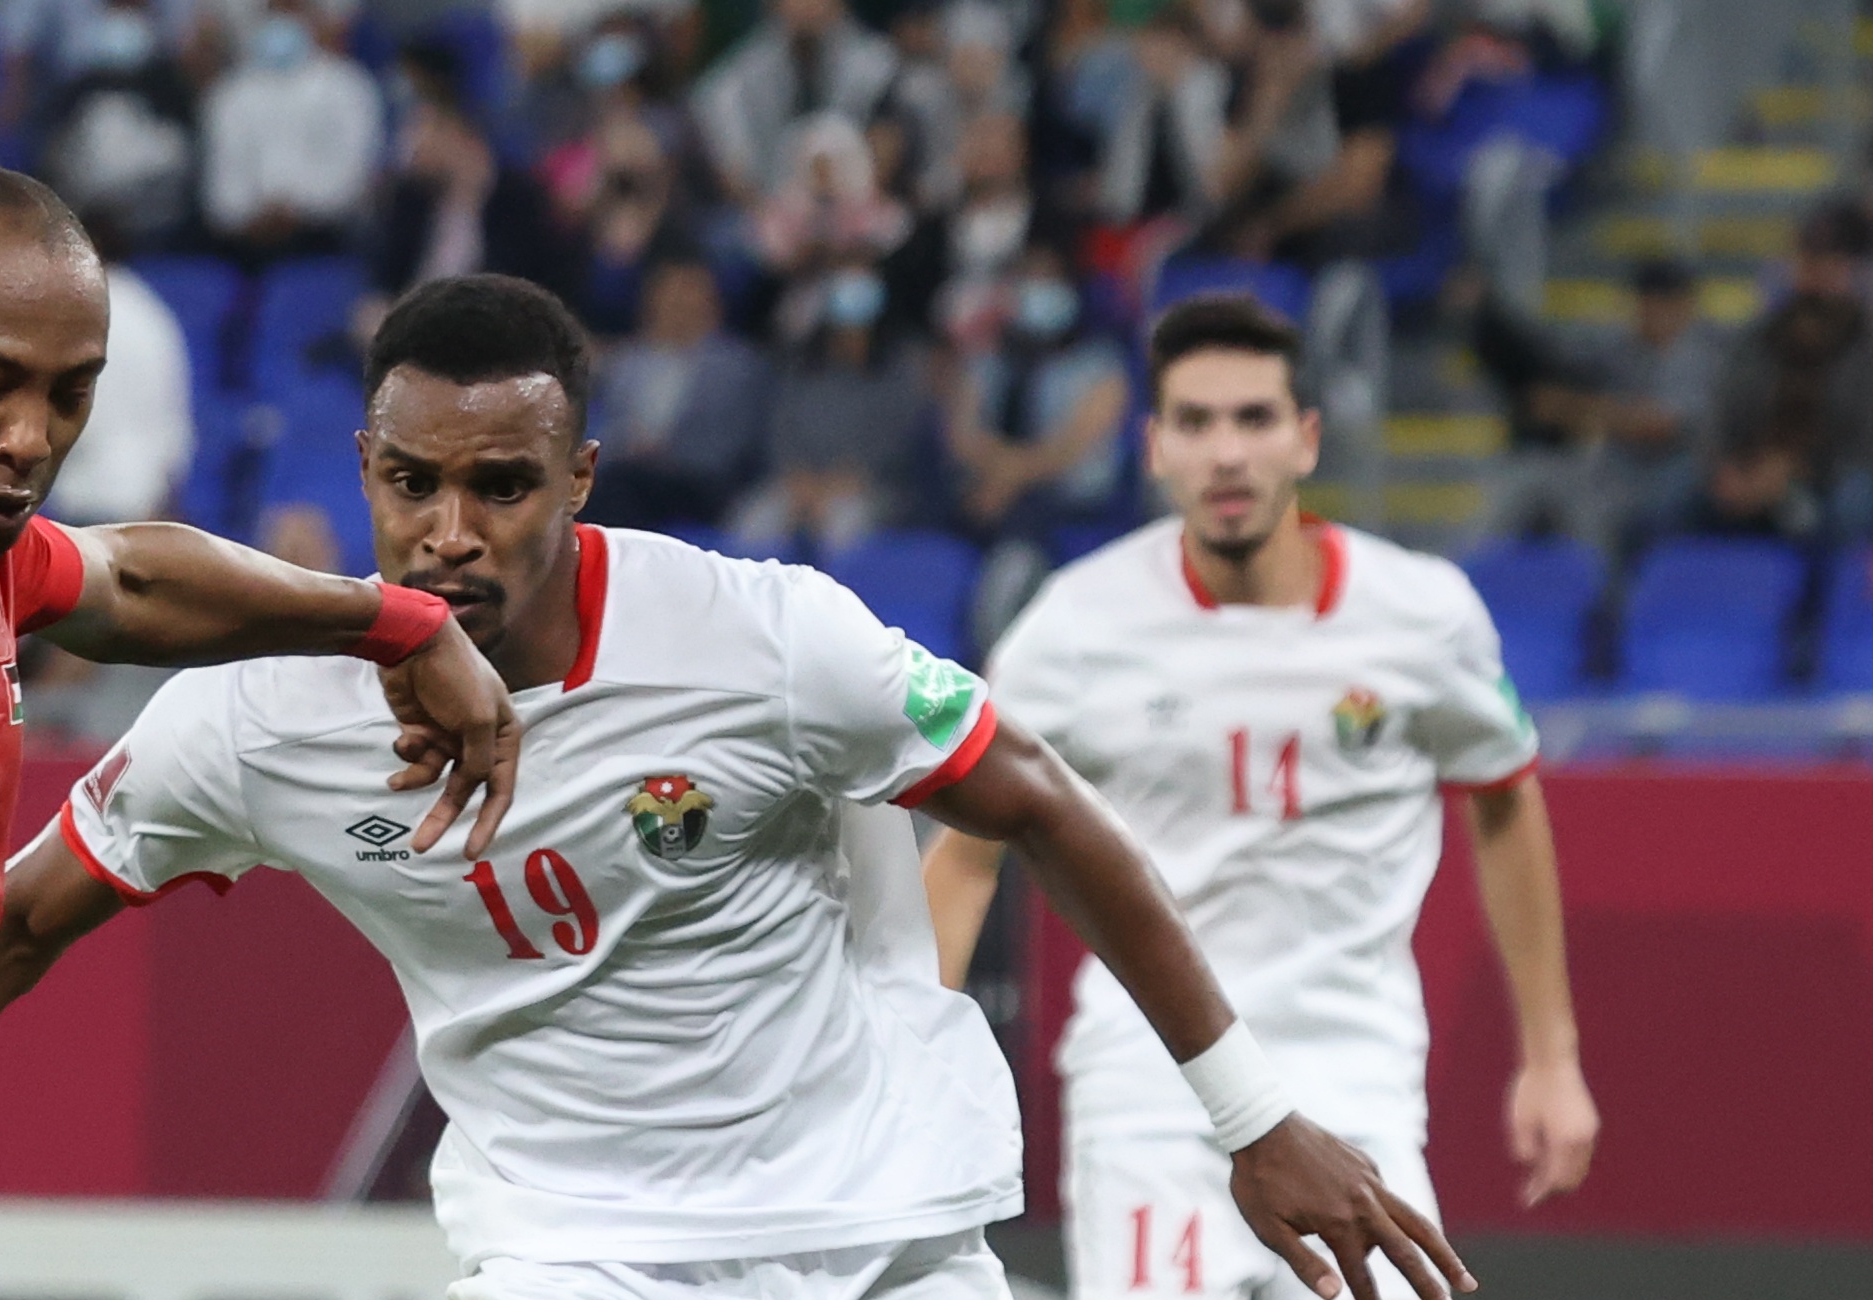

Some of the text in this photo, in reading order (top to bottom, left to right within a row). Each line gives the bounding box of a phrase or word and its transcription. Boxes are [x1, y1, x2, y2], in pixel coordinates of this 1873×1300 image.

[1226, 725, 1305, 825] 14
[356, 847, 410, 862] umbro
[462, 848, 599, 960] 19
[1127, 1203, 1205, 1294] 14
